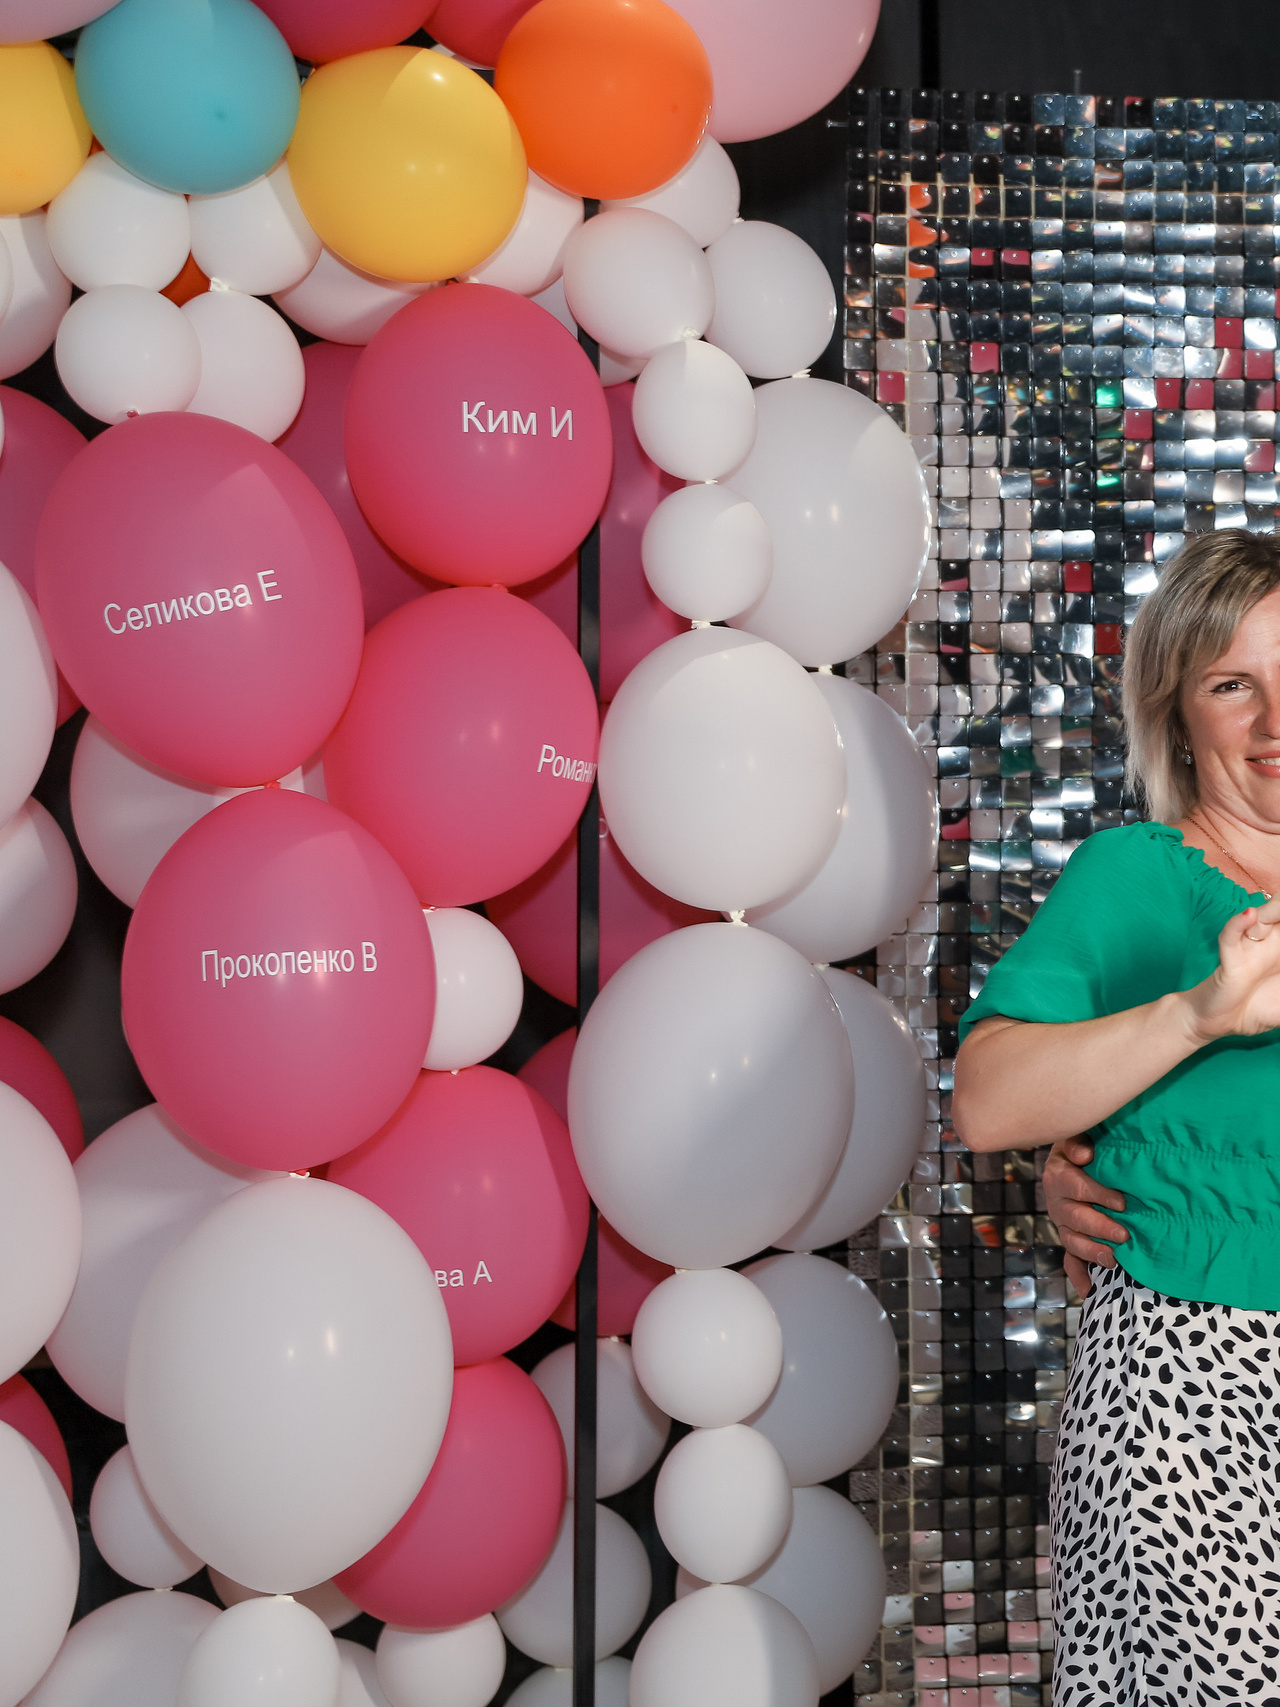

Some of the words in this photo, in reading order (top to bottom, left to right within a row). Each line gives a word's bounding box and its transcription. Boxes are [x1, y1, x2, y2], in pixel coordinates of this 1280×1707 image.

[462, 401, 537, 435] Ким
[550, 406, 573, 441] И
[103, 583, 253, 635] Селикова
[257, 569, 282, 602] Е
[202, 949, 355, 988] Прокопенко
[361, 941, 378, 972] В
[434, 1269, 464, 1288] ва
[472, 1260, 493, 1285] А
